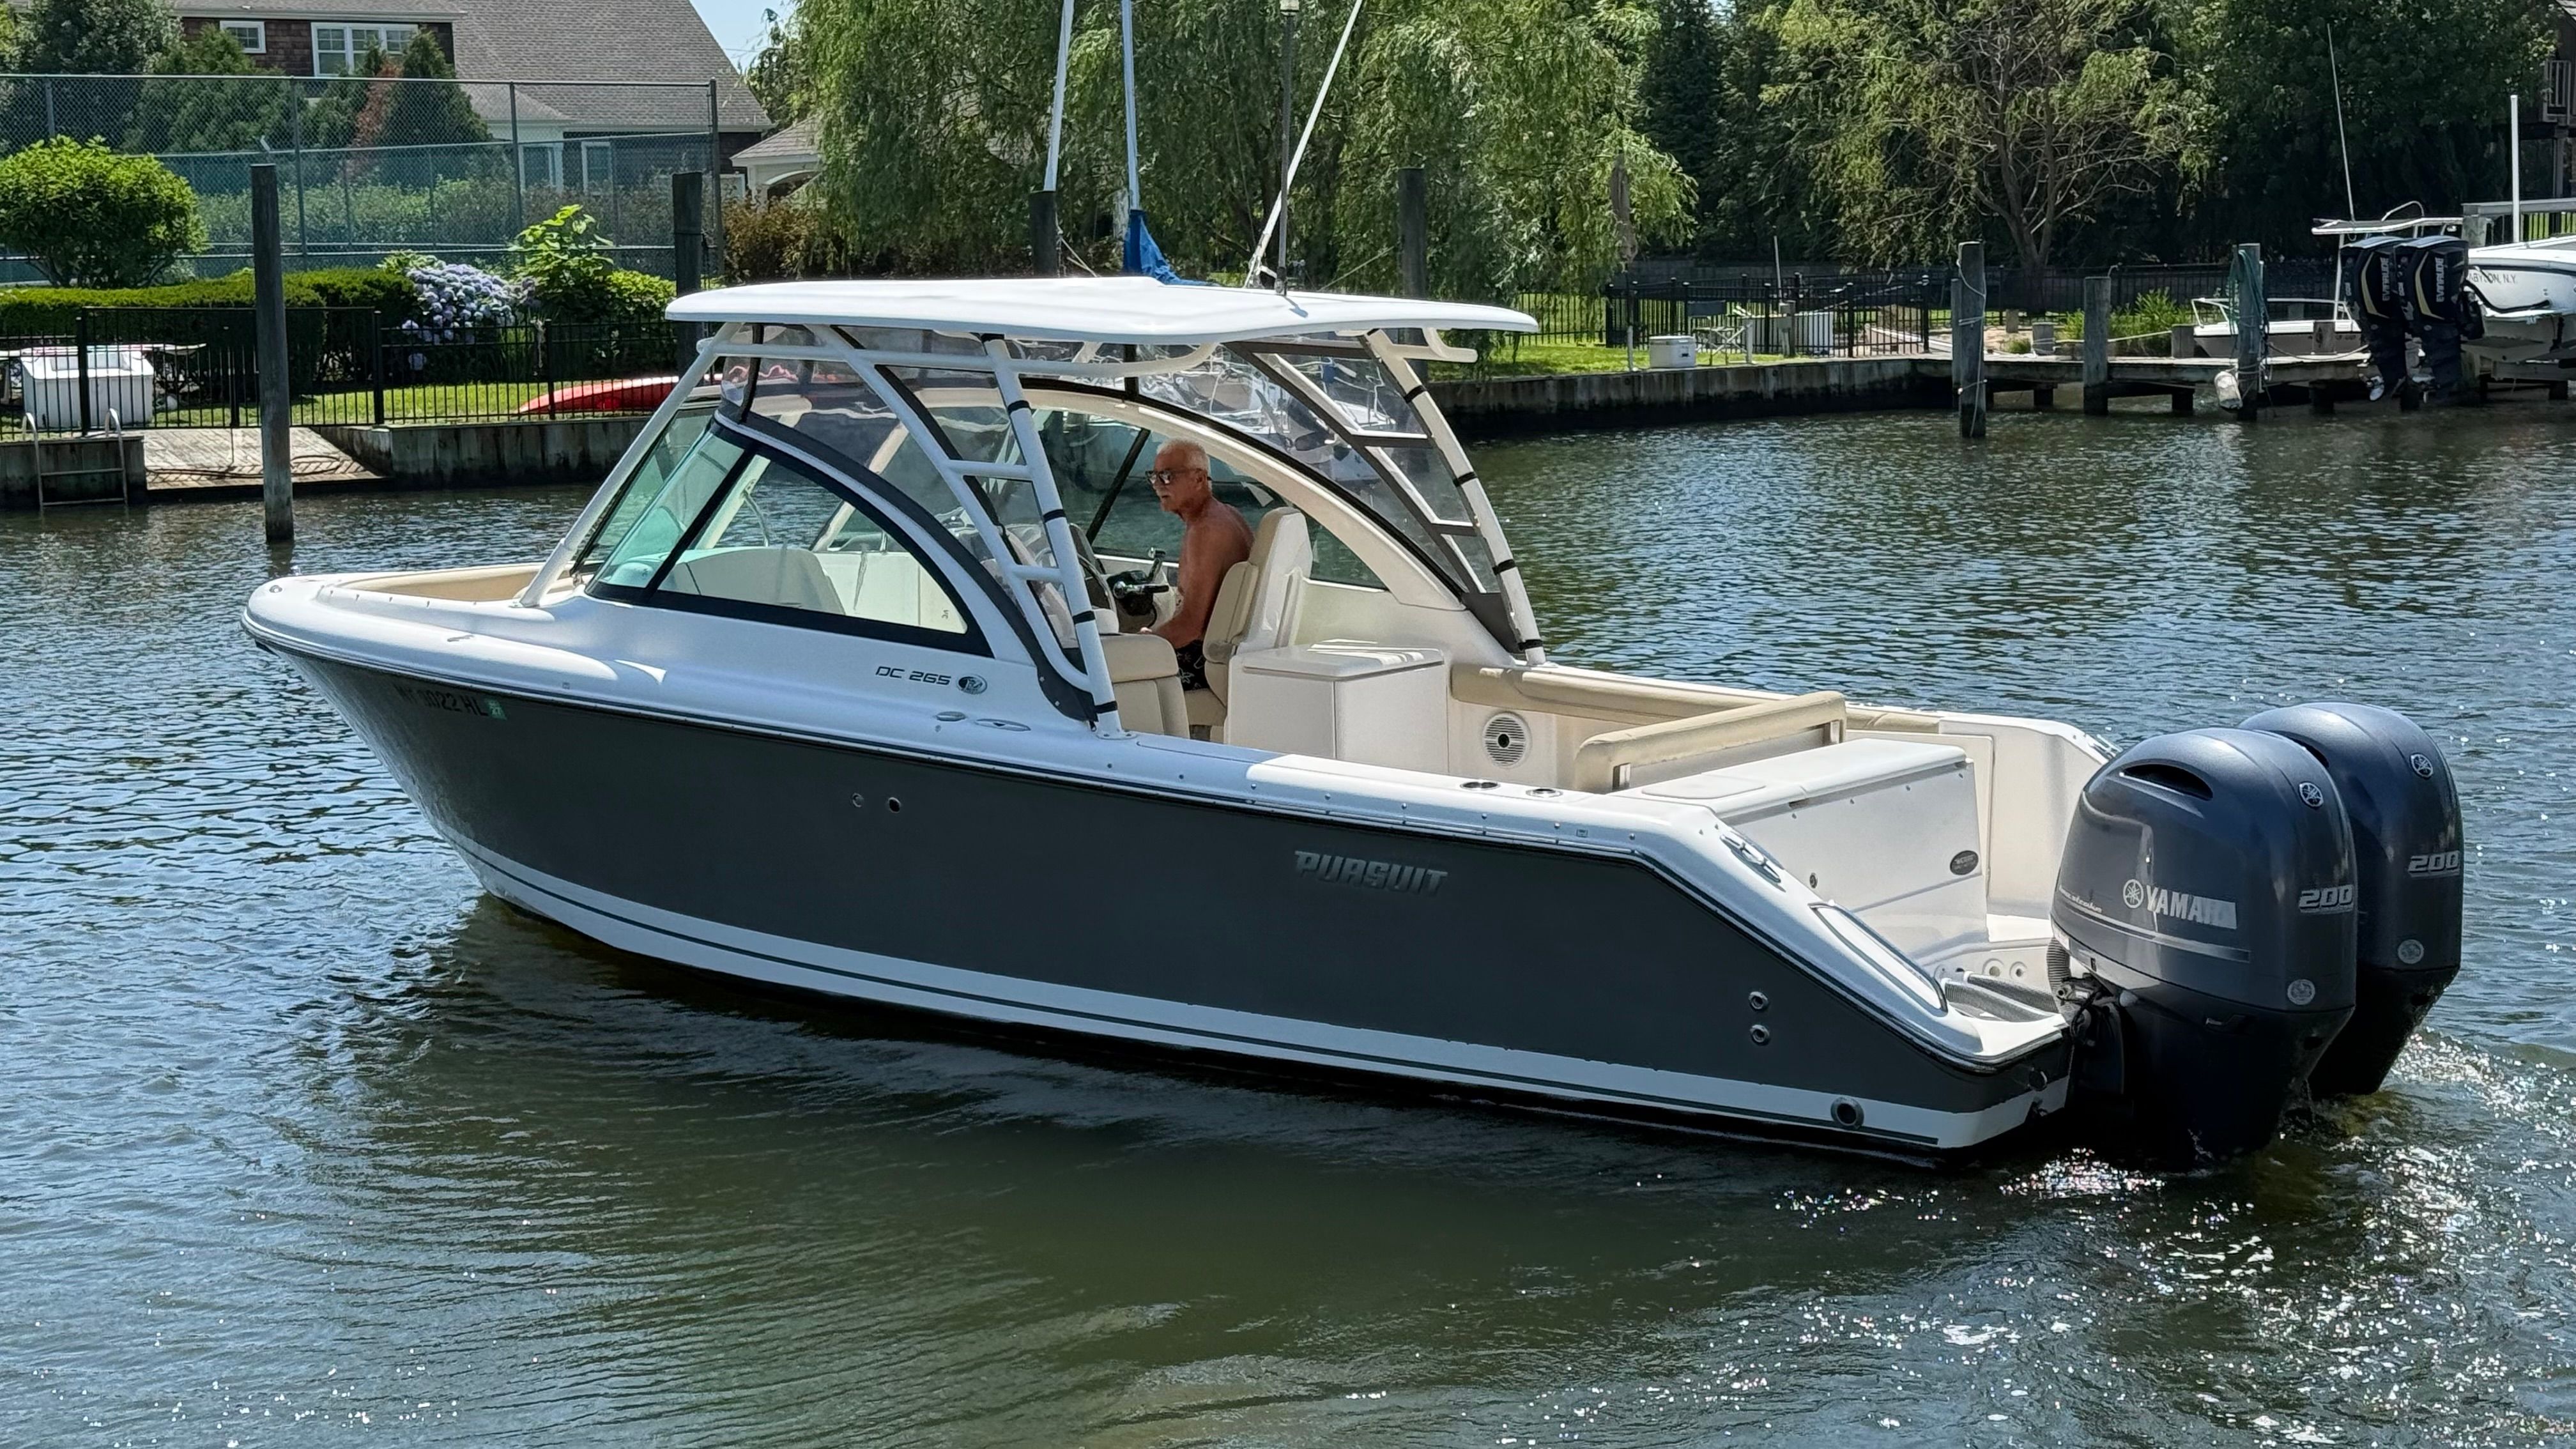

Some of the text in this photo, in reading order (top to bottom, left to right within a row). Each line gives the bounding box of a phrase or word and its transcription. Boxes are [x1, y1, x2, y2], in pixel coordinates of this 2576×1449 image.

[2435, 257, 2444, 302] EVINRUDE
[876, 666, 951, 685] DC 265
[460, 695, 489, 716] HL
[1294, 850, 1448, 894] PURSUIT
[2408, 850, 2460, 873] 200
[2299, 884, 2354, 910] 200
